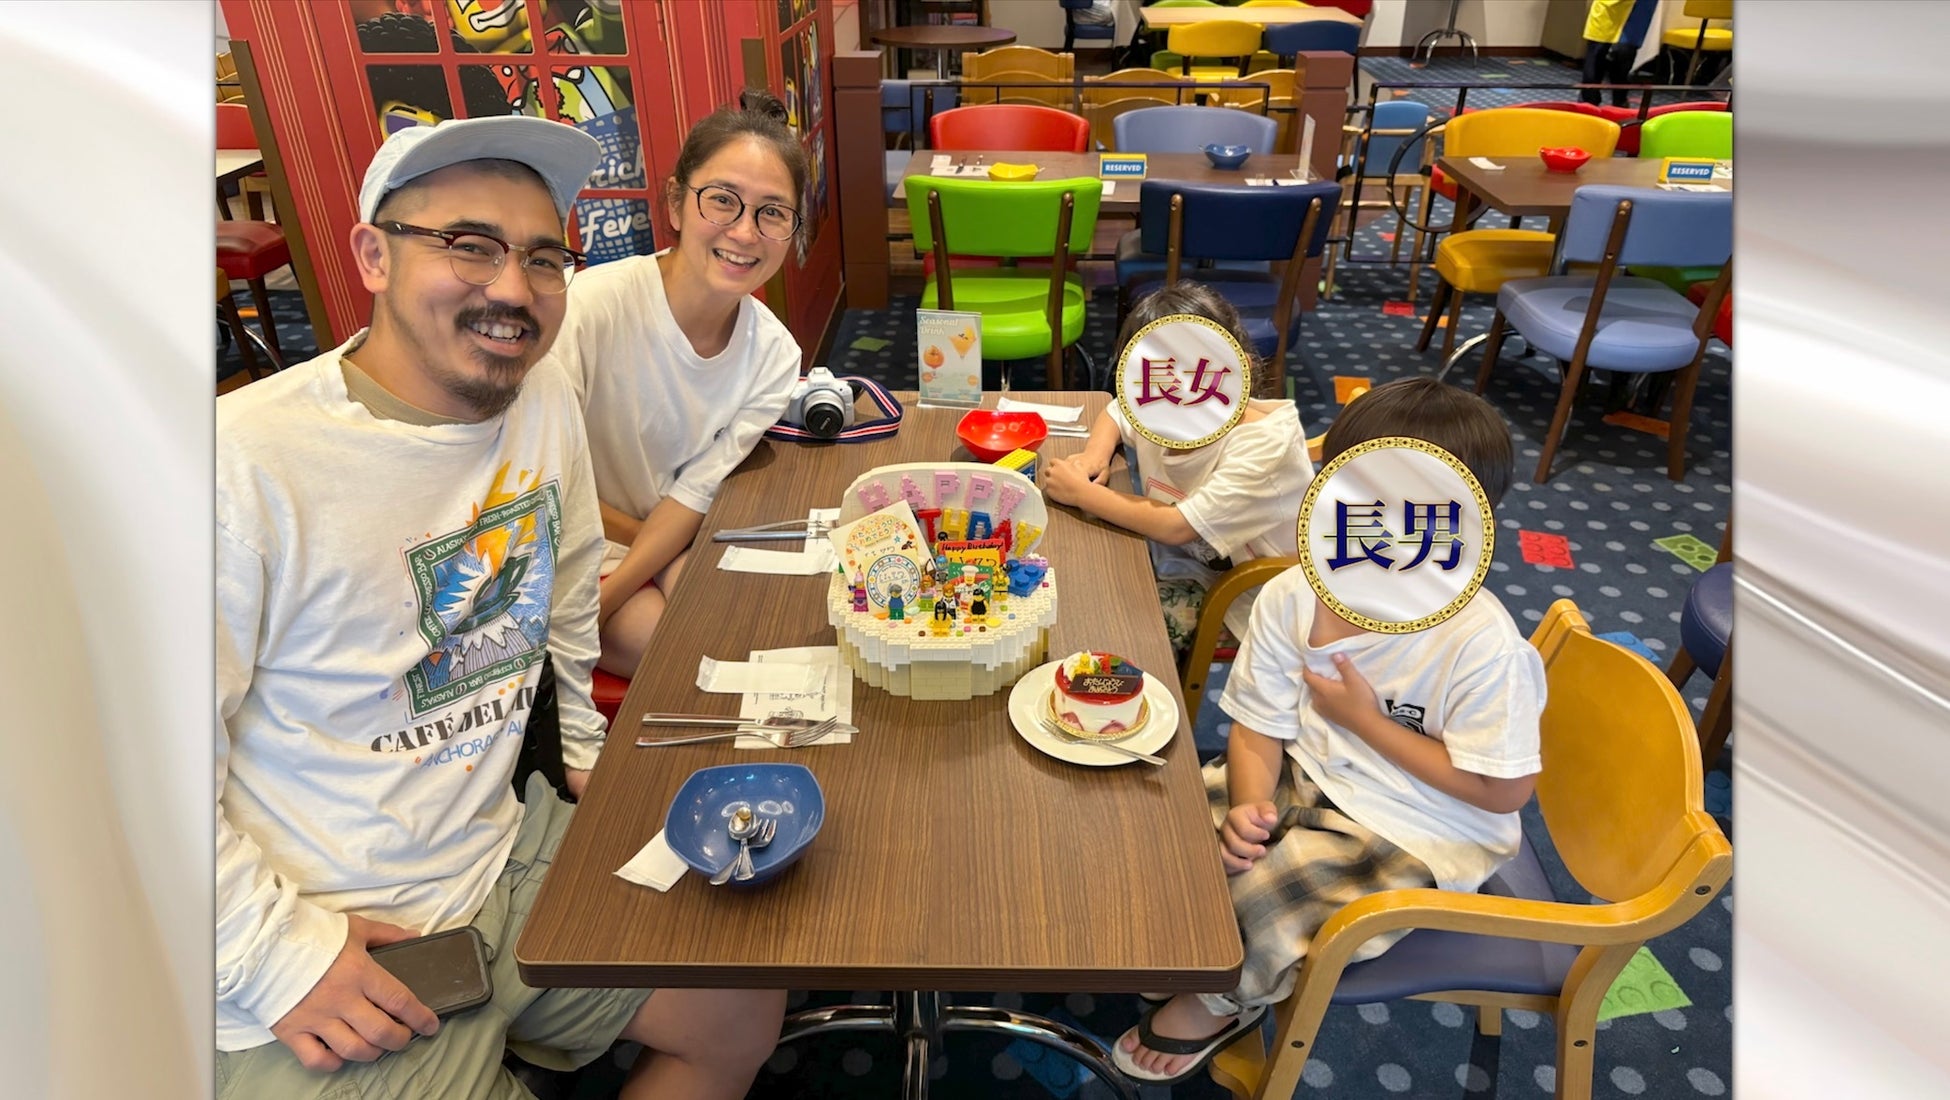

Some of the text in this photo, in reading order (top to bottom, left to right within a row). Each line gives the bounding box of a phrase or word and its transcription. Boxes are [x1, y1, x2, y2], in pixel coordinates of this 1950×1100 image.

[1671, 167, 1710, 176] RESERVED
[579, 210, 650, 253] Feve
[920, 316, 959, 327] Seasonal
[920, 326, 945, 335] Drink
[857, 471, 1026, 522] HAPPY
[941, 543, 967, 553] Happy
